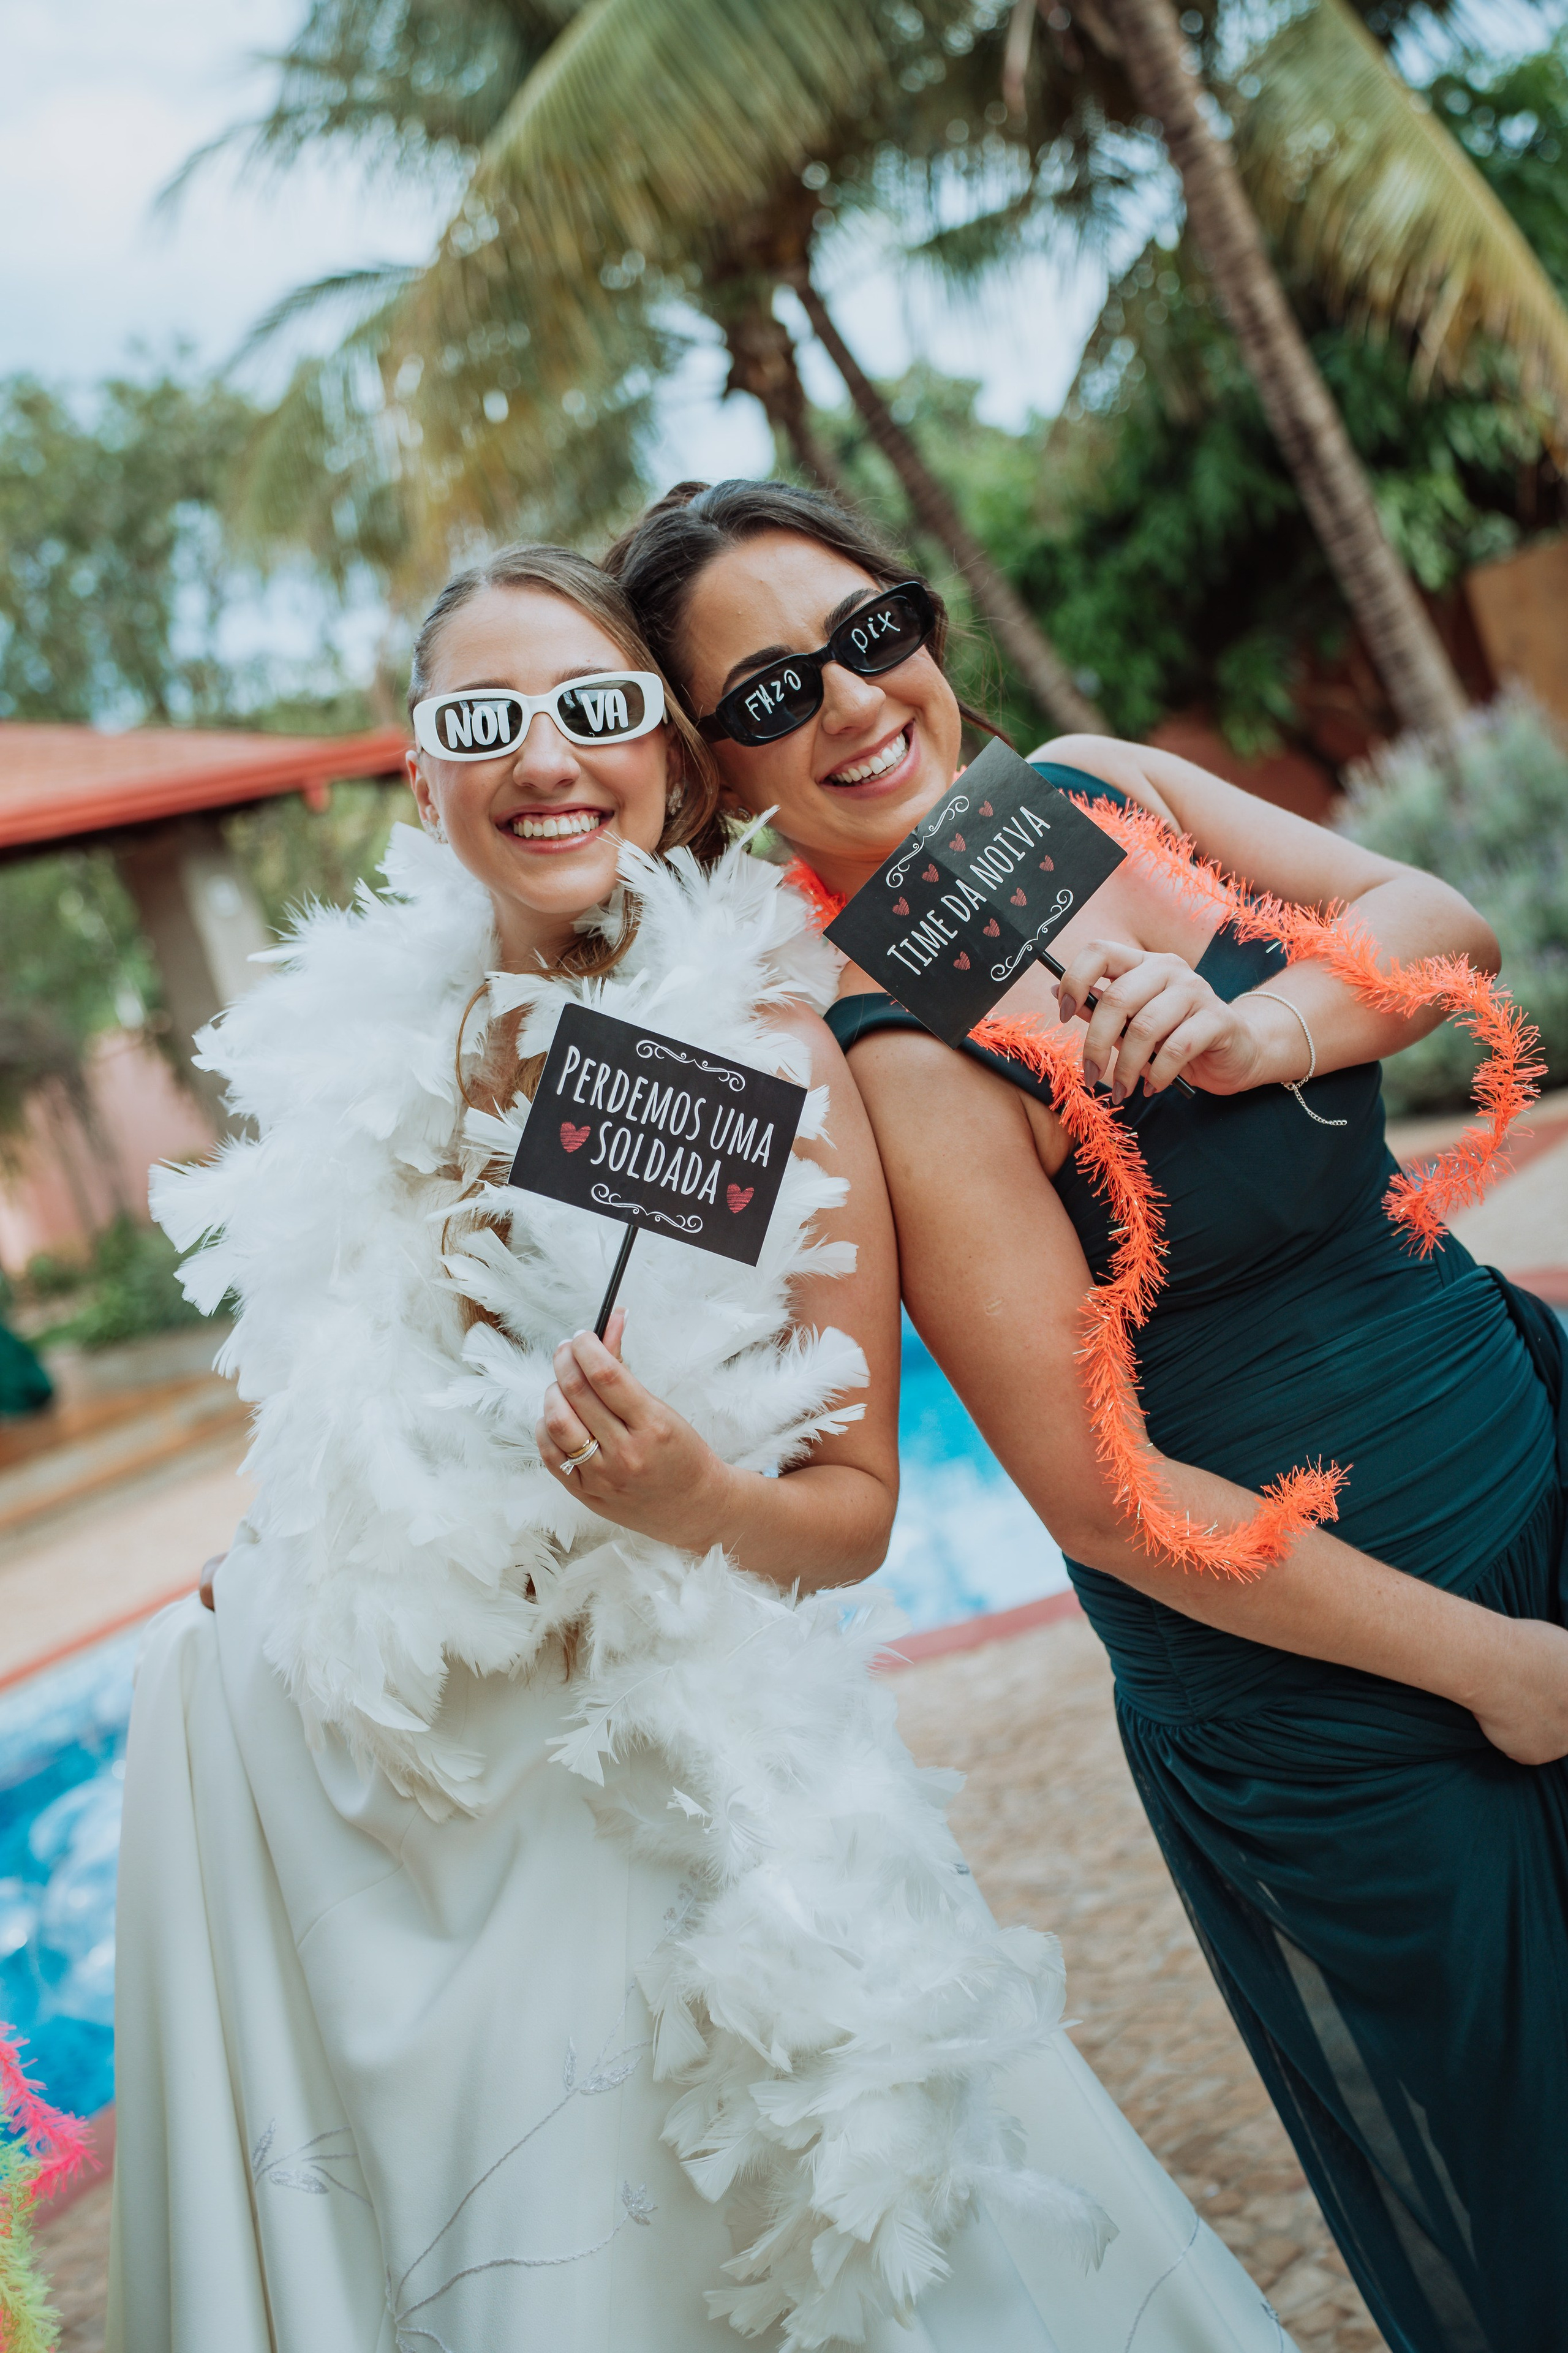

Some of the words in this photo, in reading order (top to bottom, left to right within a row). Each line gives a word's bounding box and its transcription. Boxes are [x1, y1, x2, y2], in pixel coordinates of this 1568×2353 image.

[445, 704, 511, 749] NOI
[581, 689, 628, 732] VA
[887, 910, 959, 975] TIME
[941, 880, 987, 921] DA
[970, 806, 1050, 890] NOIVA
[556, 1045, 706, 1141] PERDEMOS
[710, 1105, 774, 1167] UMA
[590, 1121, 722, 1204] SOLDADA
